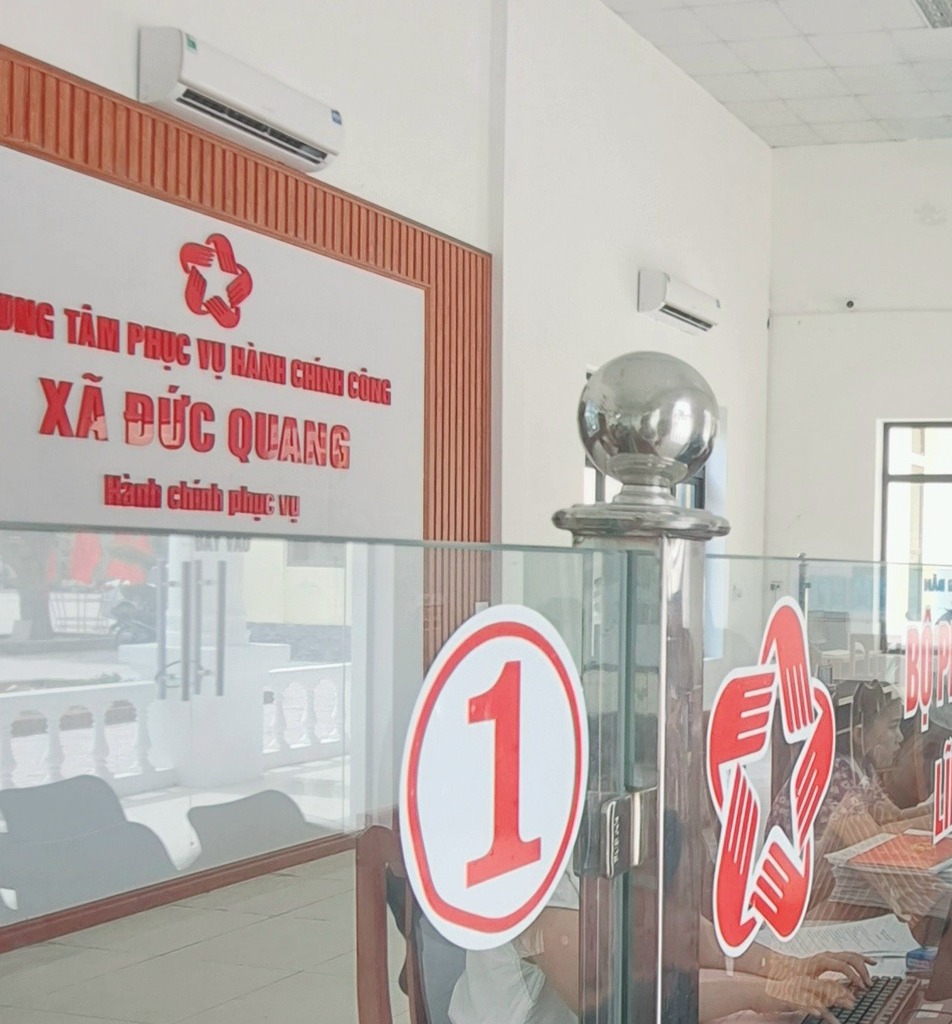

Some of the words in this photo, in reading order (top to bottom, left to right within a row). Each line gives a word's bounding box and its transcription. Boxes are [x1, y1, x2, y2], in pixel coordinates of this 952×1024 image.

[64, 304, 120, 353] TÂM
[127, 322, 191, 371] PHỤC
[196, 338, 226, 380] VỤ
[230, 342, 286, 385] HÀNH
[290, 357, 344, 396] CHÍNH
[347, 367, 391, 405] CÔNG
[38, 373, 109, 441] XÃ
[123, 385, 215, 452] ĐỨC
[227, 408, 350, 469] QUANG
[104, 473, 162, 508] Hành
[167, 479, 224, 512] chính
[228, 486, 275, 521] phục
[279, 495, 300, 523] vụ
[904, 606, 933, 731] BỘ
[466, 660, 541, 888] 1
